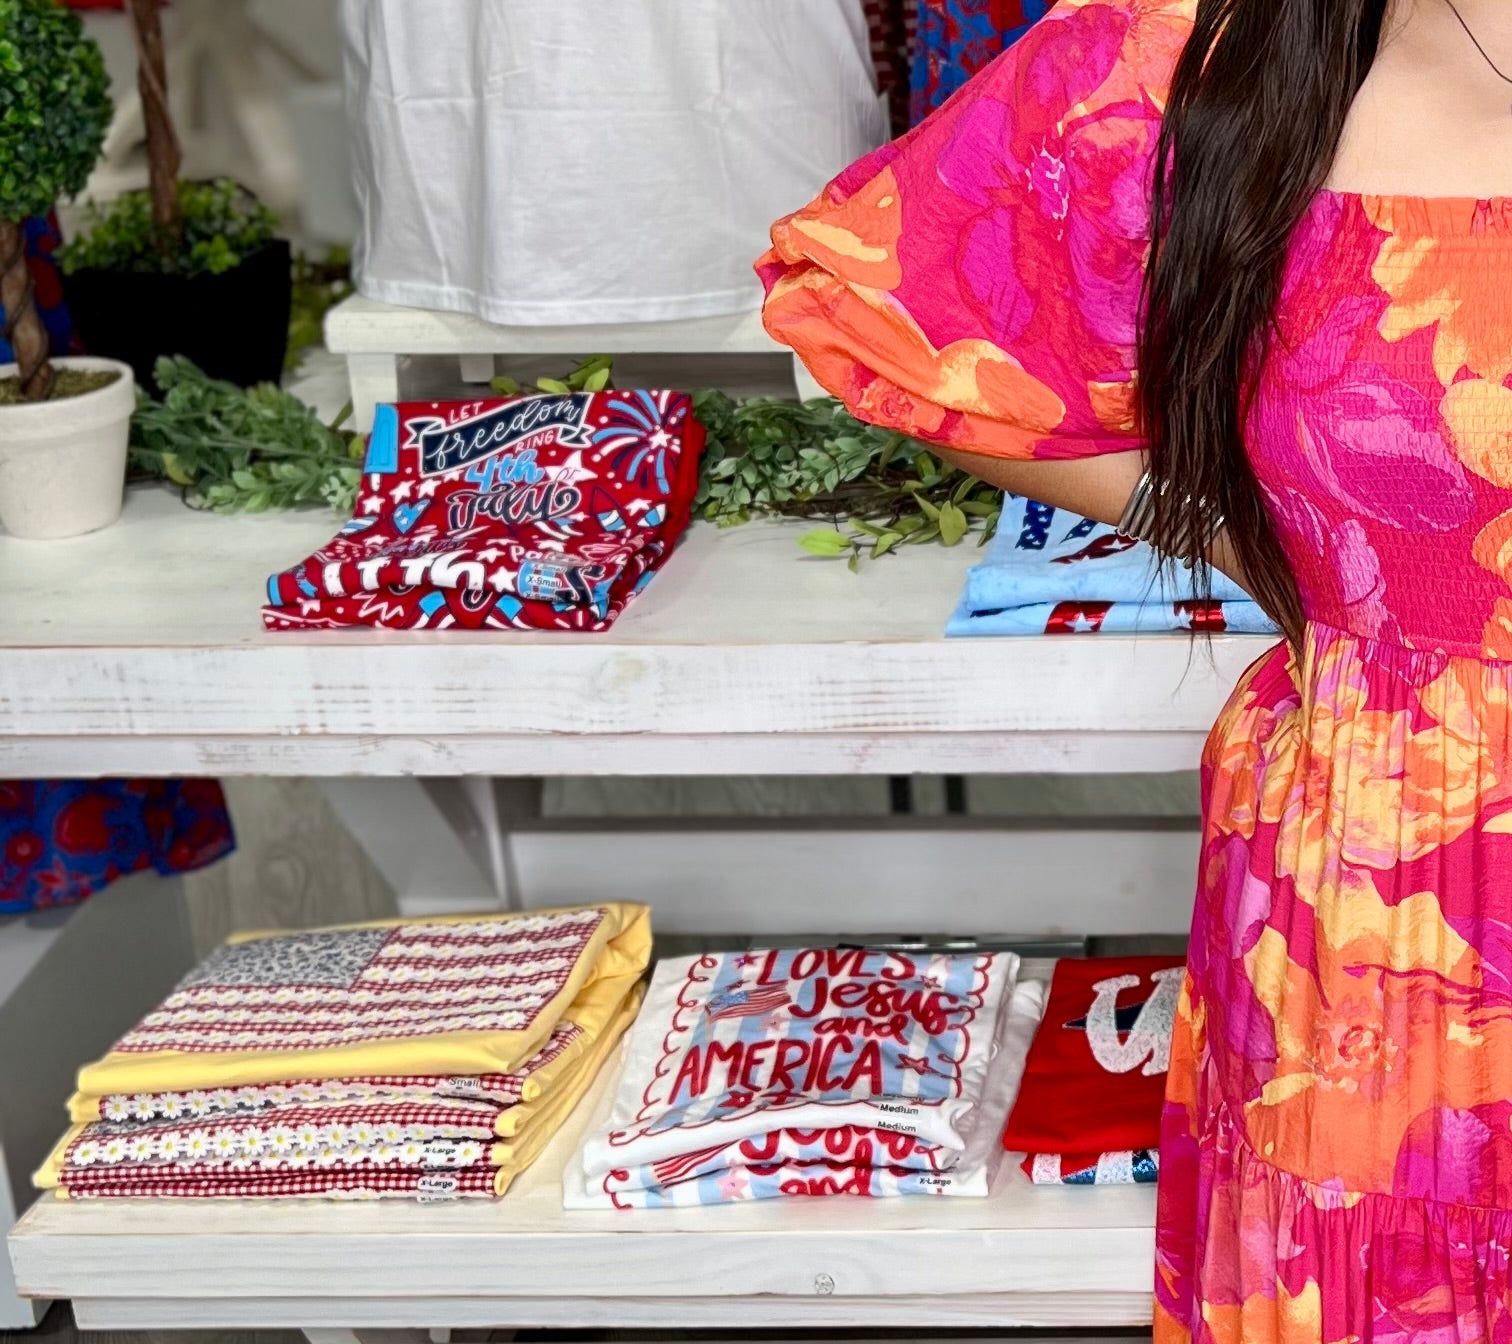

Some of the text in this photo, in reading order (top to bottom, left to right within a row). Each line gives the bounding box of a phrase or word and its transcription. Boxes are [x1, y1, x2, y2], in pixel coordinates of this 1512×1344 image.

[450, 401, 484, 424] LET
[425, 399, 581, 470] freedom
[515, 429, 554, 455] RING
[464, 448, 546, 494] 4th
[787, 976, 960, 1036] Jesus
[813, 1016, 910, 1046] and
[669, 1034, 884, 1105] AMERICA
[880, 1103, 919, 1115] Medium
[877, 1120, 917, 1133] Medium
[420, 1179, 453, 1189] X-Large
